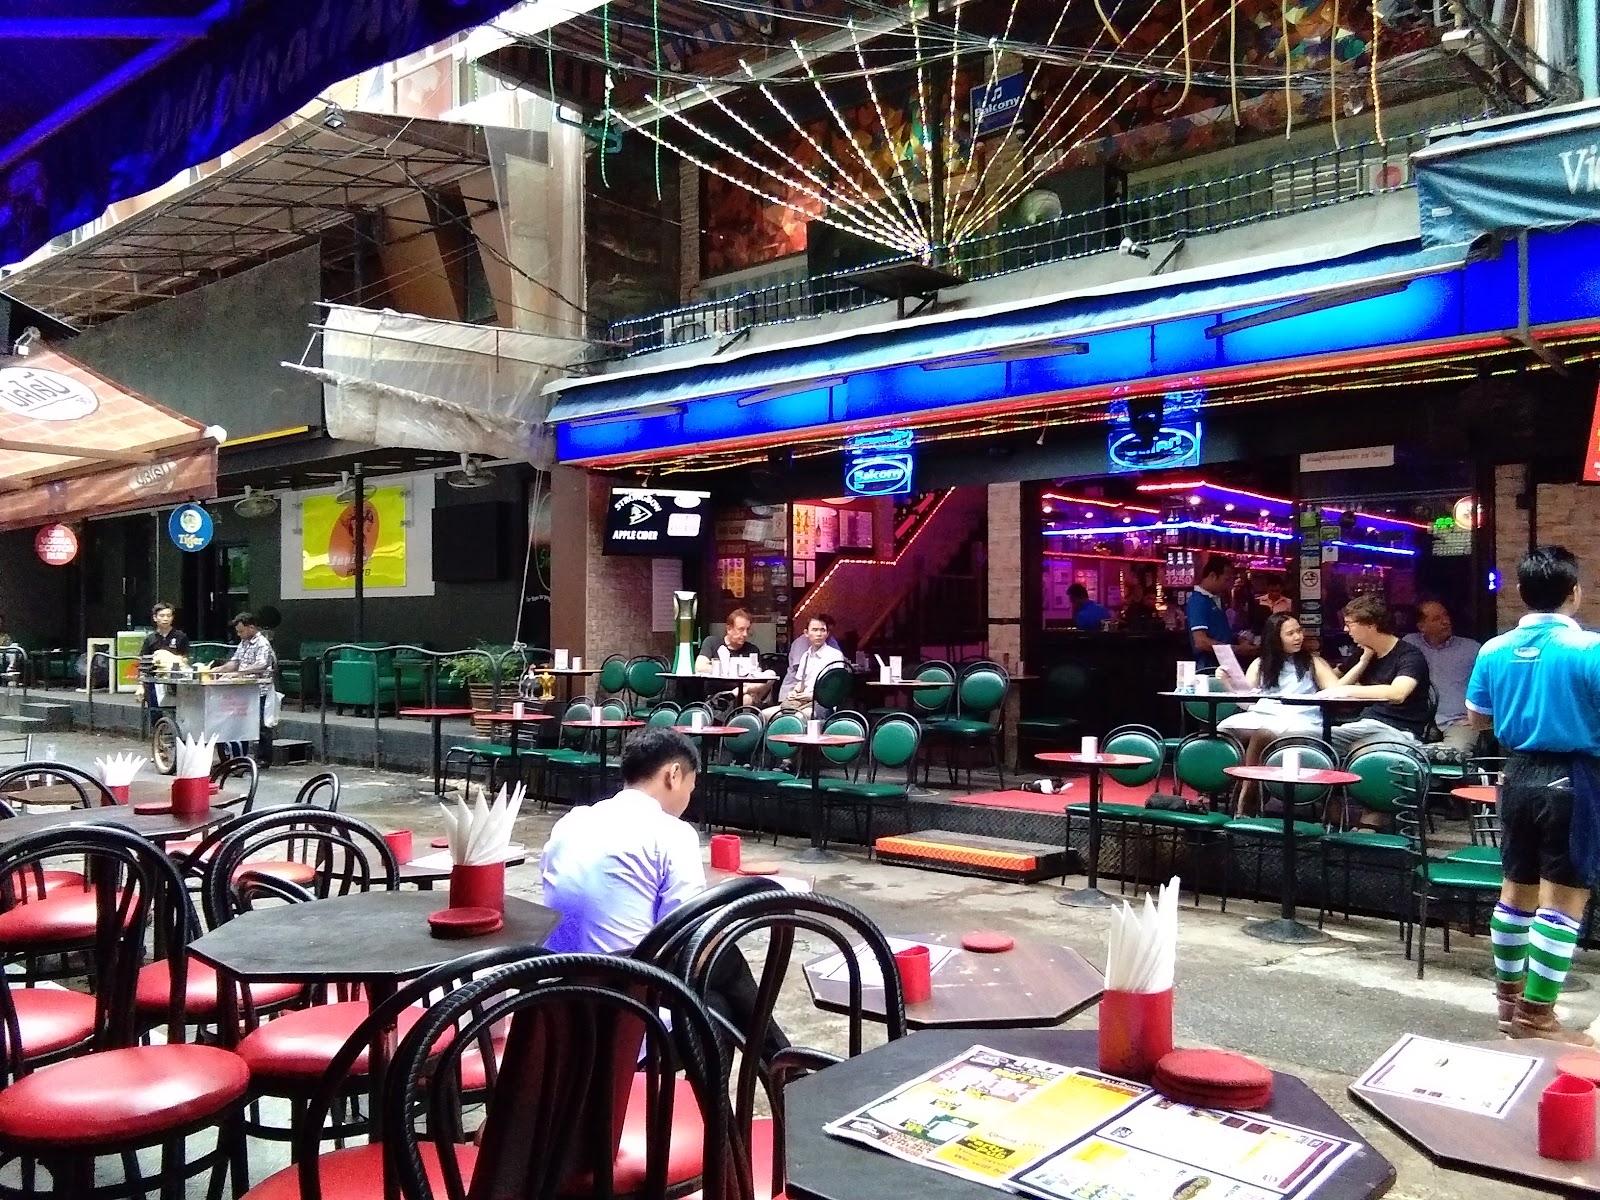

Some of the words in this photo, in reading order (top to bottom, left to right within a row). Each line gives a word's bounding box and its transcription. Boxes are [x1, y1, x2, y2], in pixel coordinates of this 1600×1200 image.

[974, 95, 1020, 125] Balcony
[614, 492, 663, 512] STRONGBOW
[40, 536, 72, 545] VODKA
[178, 533, 204, 549] Tiger
[612, 530, 636, 540] APPLE
[636, 530, 659, 541] CIDER
[38, 544, 75, 553] SCOTCH
[1166, 574, 1193, 585] 1250
